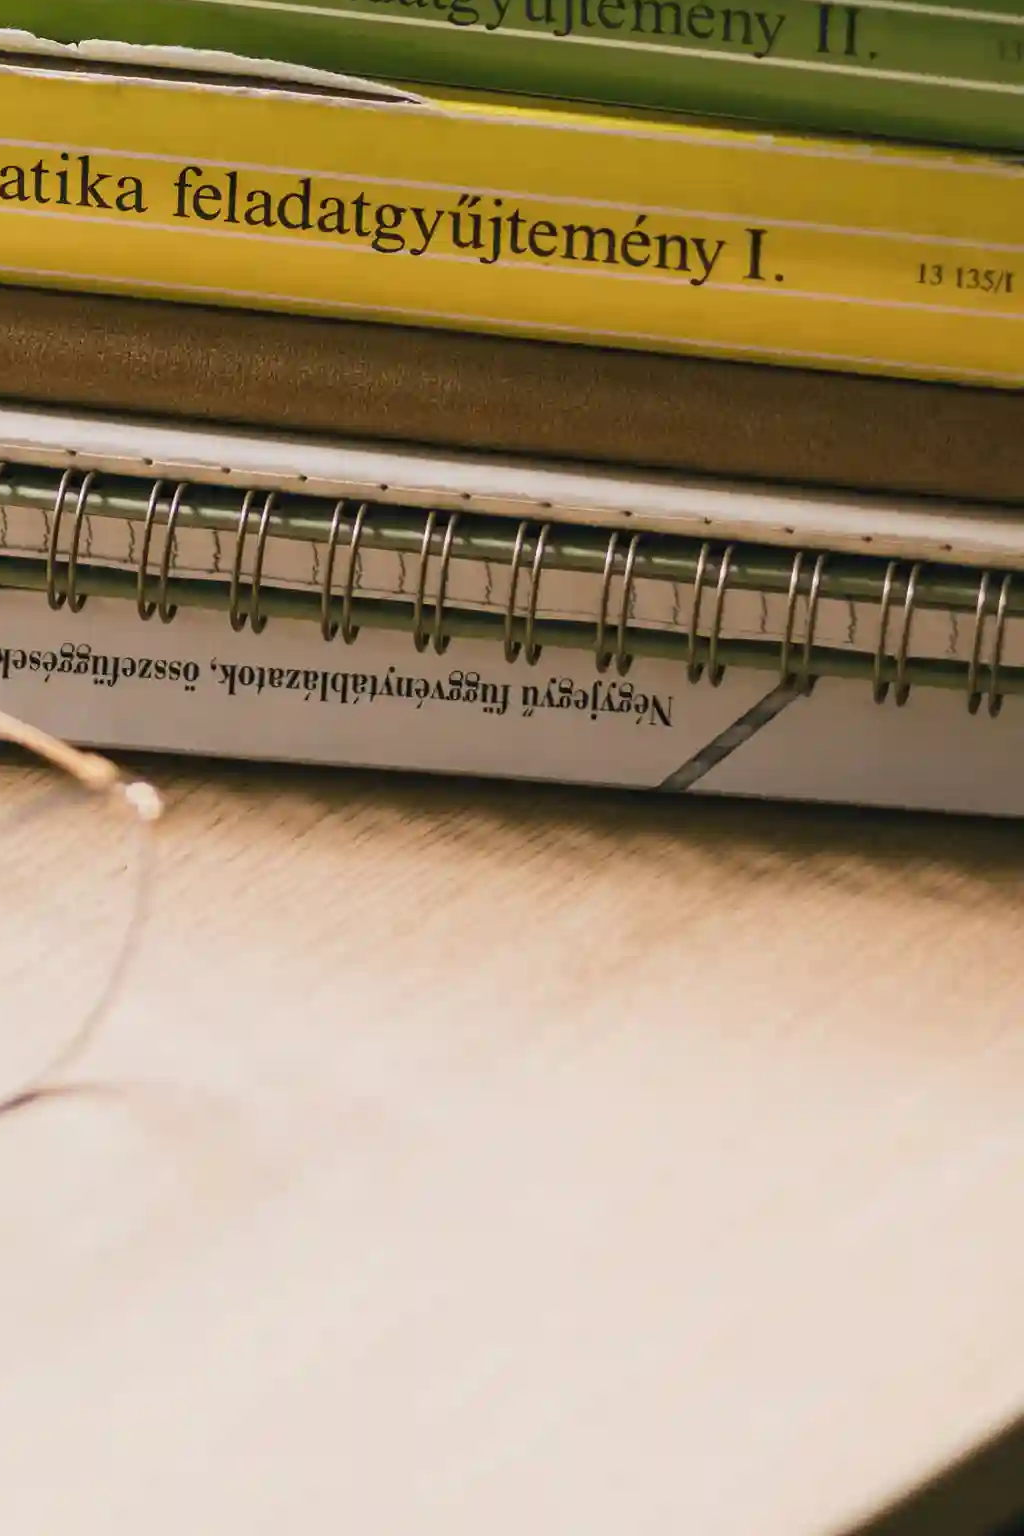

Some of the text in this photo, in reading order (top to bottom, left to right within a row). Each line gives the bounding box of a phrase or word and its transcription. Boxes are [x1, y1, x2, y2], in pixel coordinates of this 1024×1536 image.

[816, 3, 879, 61] II.
[172, 165, 728, 286] feladatgyűjtemény
[741, 227, 786, 284] I.
[915, 263, 943, 286] 13
[209, 659, 511, 716] függvénytáblázatok,
[522, 676, 674, 727] Négyjegyű
